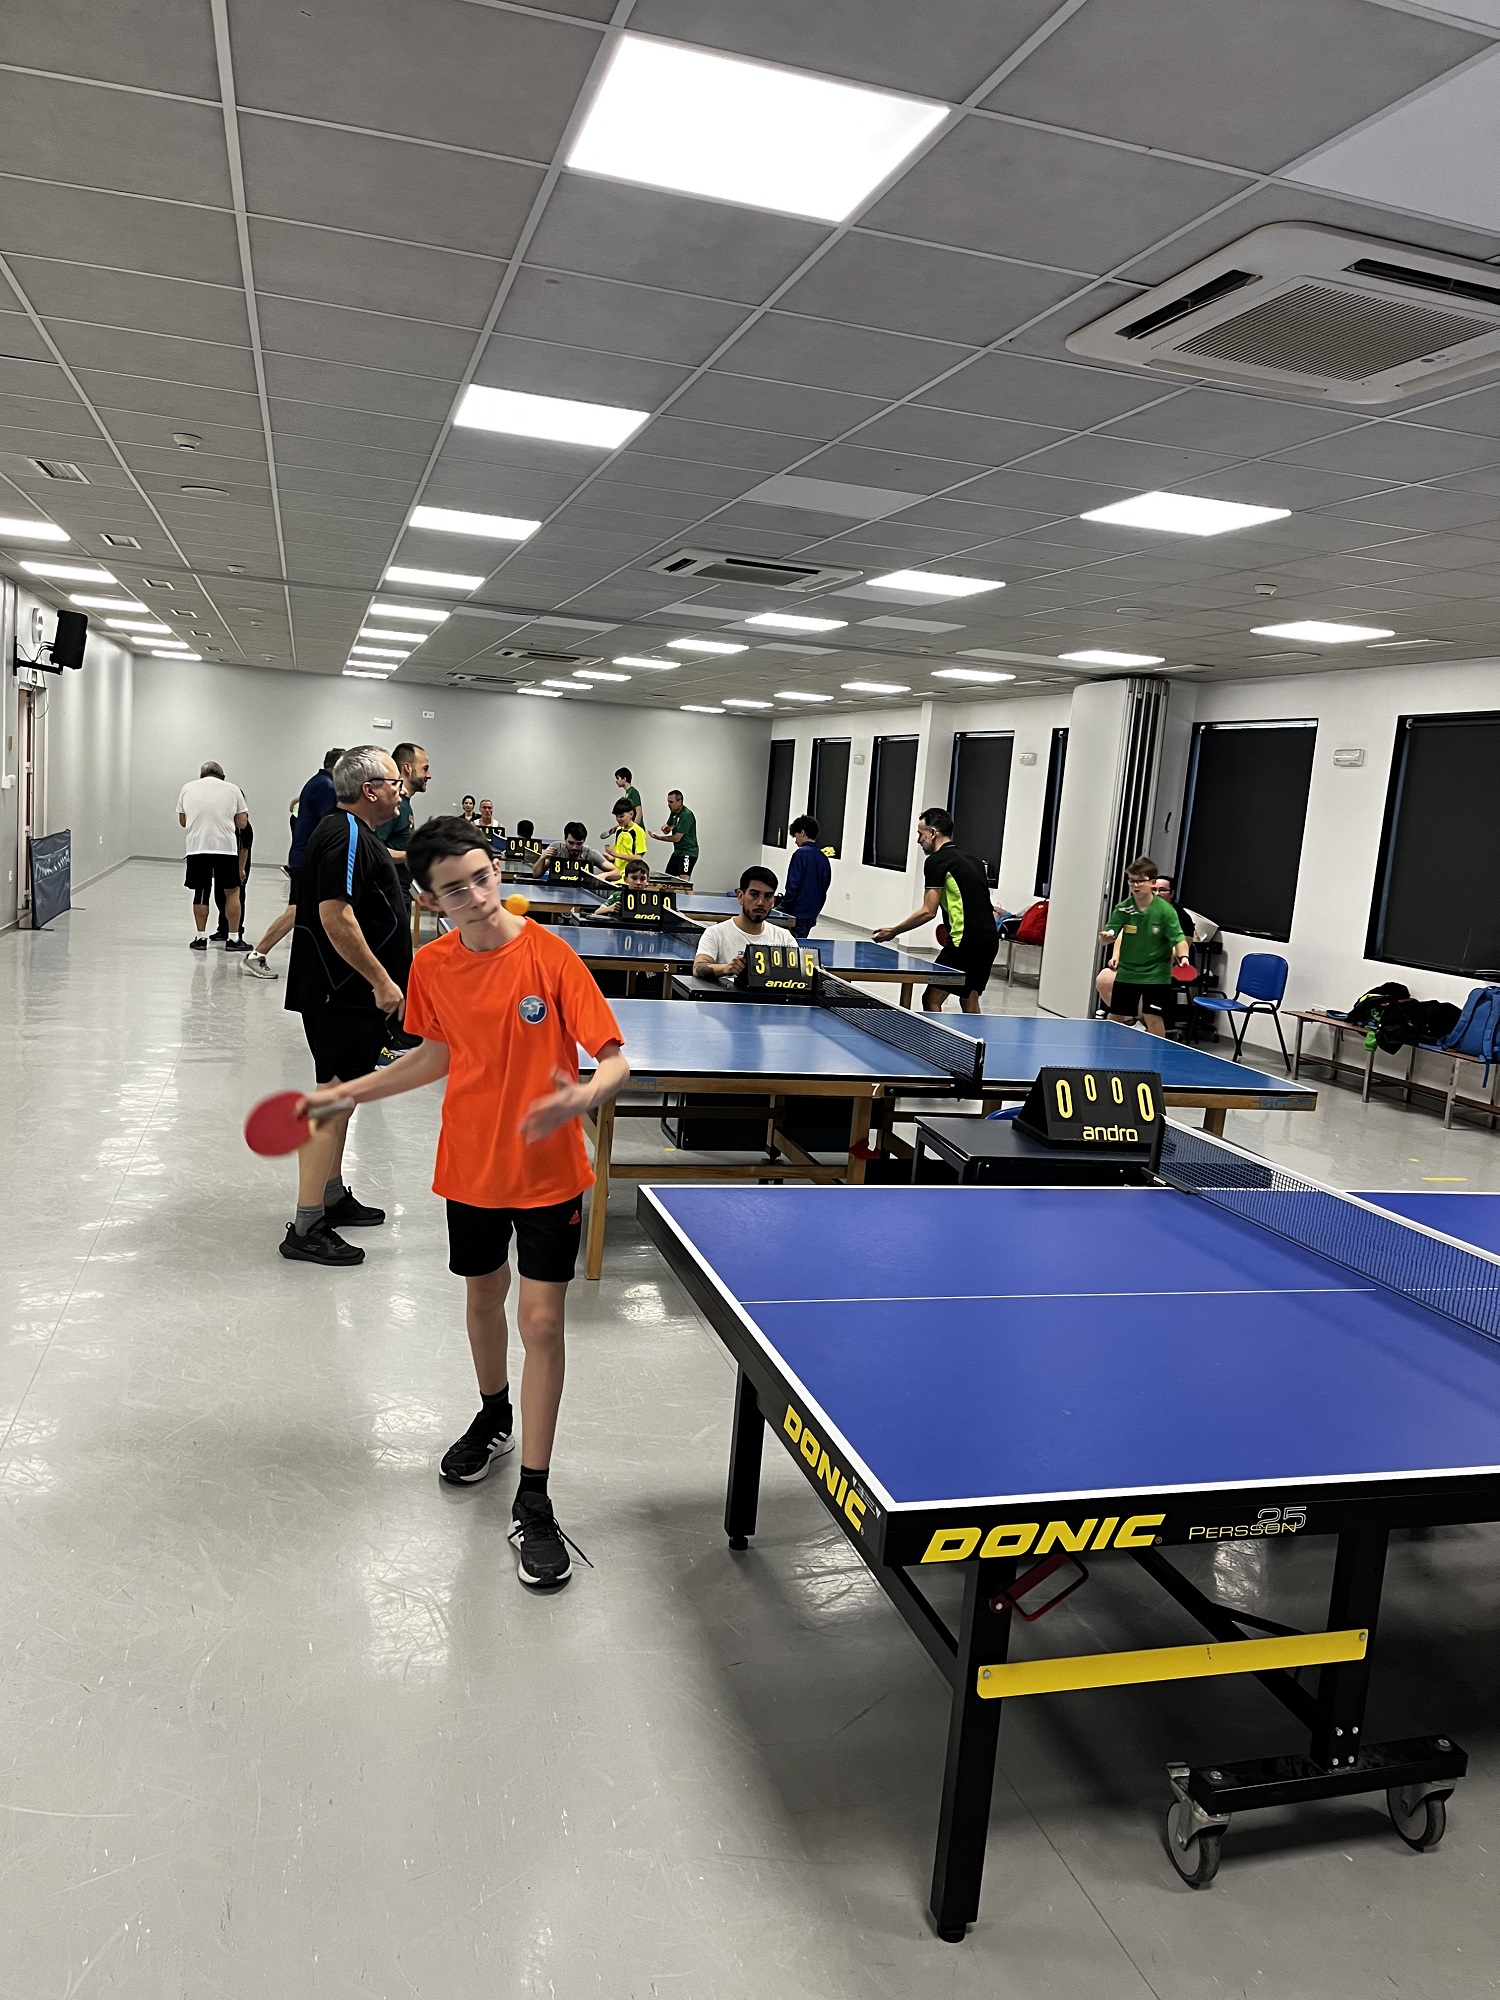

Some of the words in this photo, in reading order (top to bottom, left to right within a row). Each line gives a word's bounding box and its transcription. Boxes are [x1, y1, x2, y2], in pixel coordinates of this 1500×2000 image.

[510, 840, 516, 851] 0
[554, 860, 561, 873] 8
[566, 860, 570, 869] 1
[574, 861, 580, 870] 0
[627, 893, 635, 910] 0
[641, 893, 647, 905] 0
[652, 894, 658, 906] 0
[663, 963, 670, 973] 3
[754, 951, 766, 975] 3
[773, 950, 781, 967] 0
[788, 951, 796, 968] 0
[804, 953, 815, 977] 5
[765, 979, 807, 989] andro
[871, 1083, 881, 1097] 7
[1055, 1079, 1074, 1119] 0
[1083, 1074, 1097, 1102] 0
[1111, 1076, 1124, 1104] 0
[1136, 1082, 1155, 1122] 0
[1082, 1124, 1139, 1142] andro
[783, 1403, 867, 1532] DONIC
[1188, 1521, 1297, 1540] PERSSON
[1257, 1506, 1307, 1529] 25
[920, 1513, 1167, 1564] DONIC
